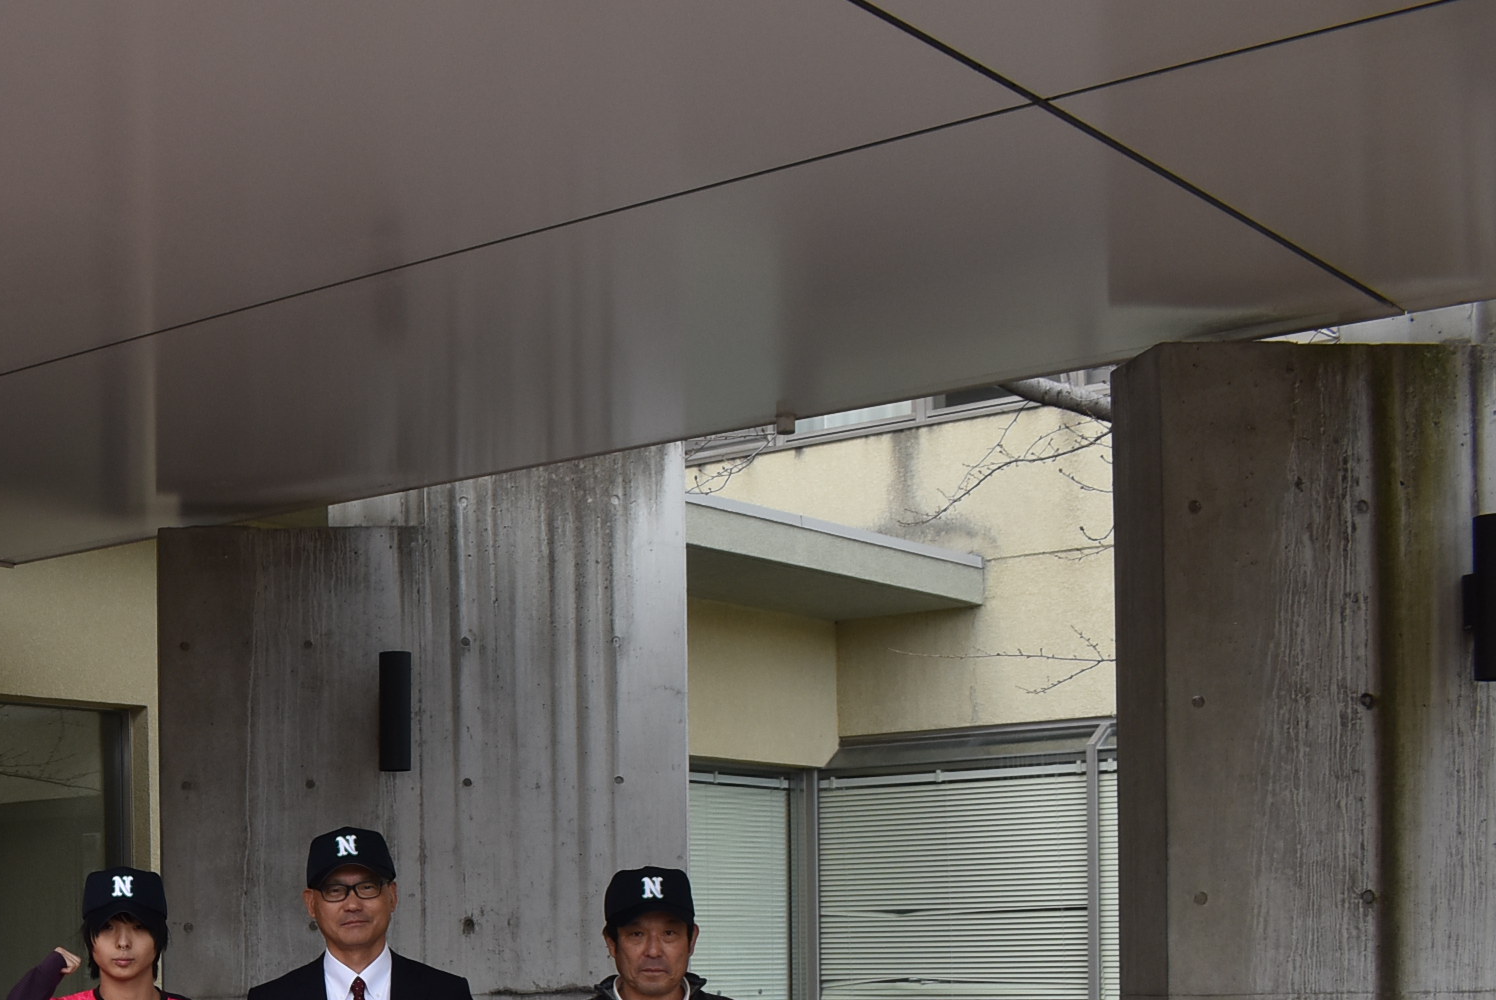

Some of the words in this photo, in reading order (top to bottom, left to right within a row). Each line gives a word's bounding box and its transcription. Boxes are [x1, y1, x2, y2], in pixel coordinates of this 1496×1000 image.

[335, 834, 358, 857] N
[111, 875, 134, 897] N
[641, 876, 664, 899] N
